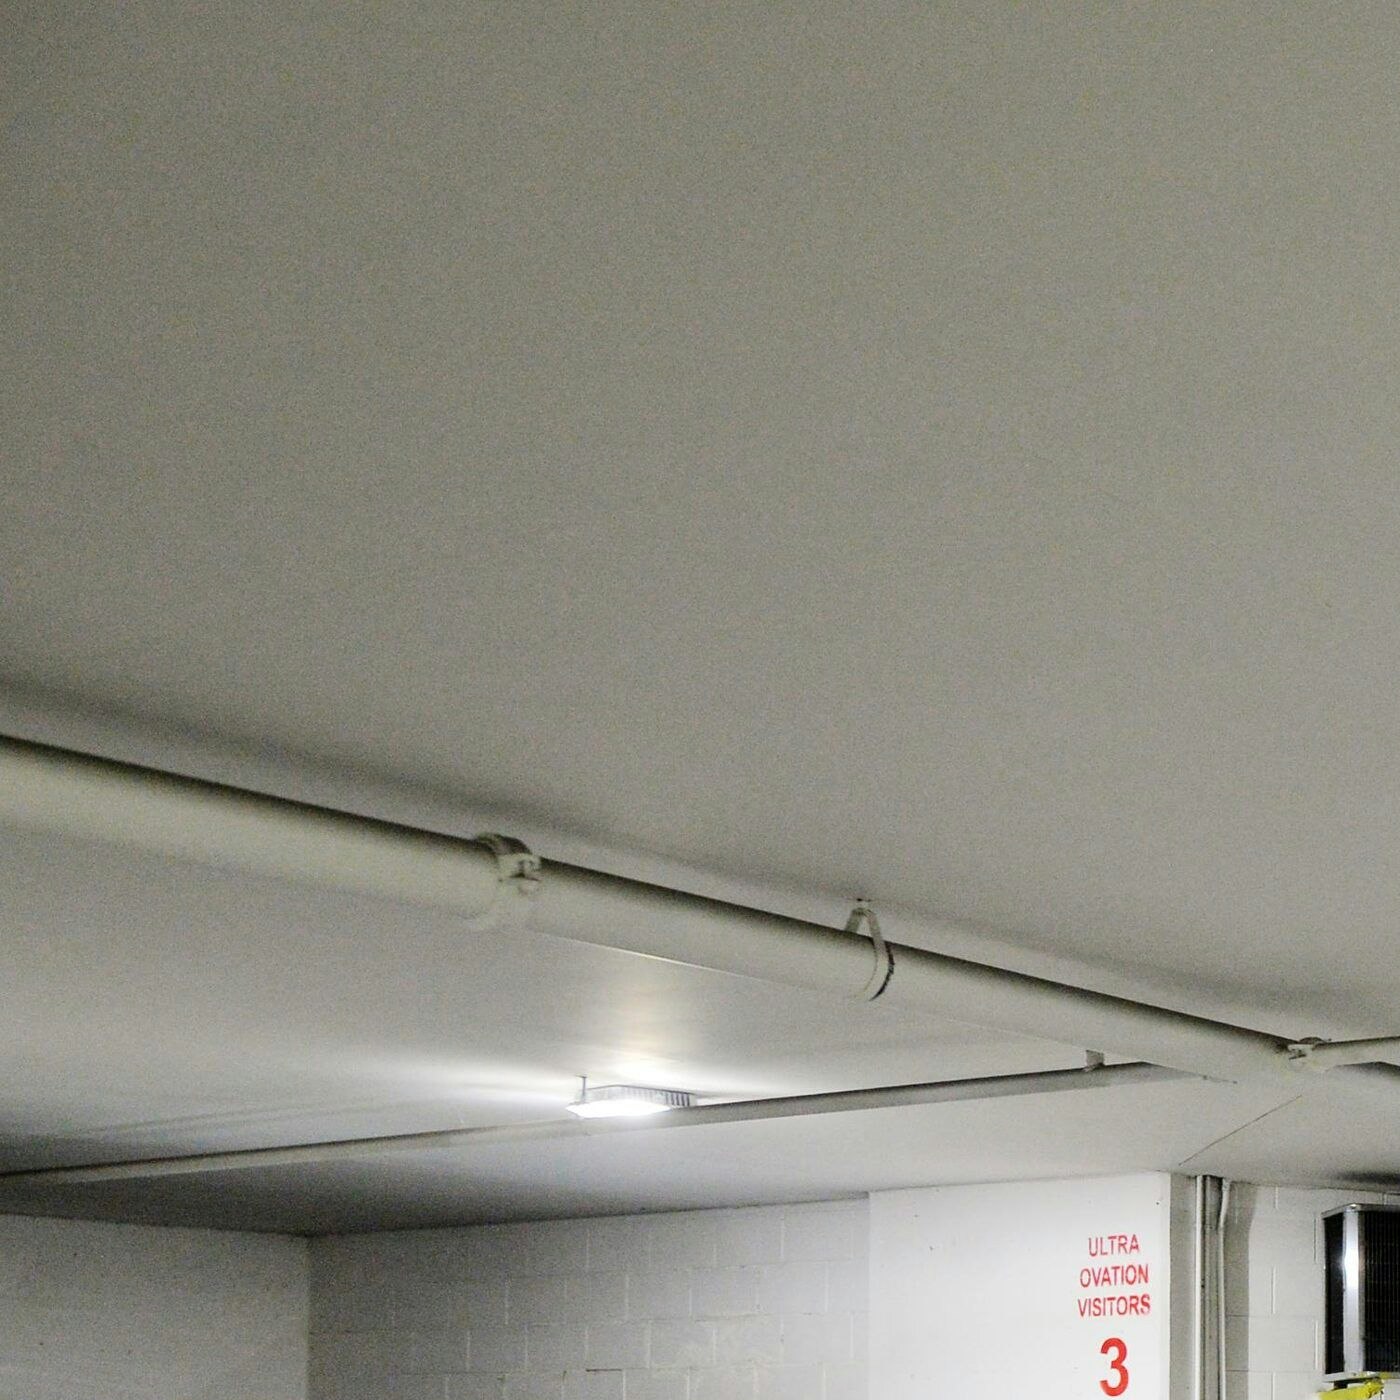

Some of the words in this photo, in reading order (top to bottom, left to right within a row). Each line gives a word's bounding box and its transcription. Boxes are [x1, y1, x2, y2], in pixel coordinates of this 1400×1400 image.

[1088, 1234, 1140, 1257] ULTRA
[1080, 1264, 1149, 1288] OVATION
[1077, 1293, 1150, 1318] VISITORS
[1100, 1337, 1129, 1397] 3
